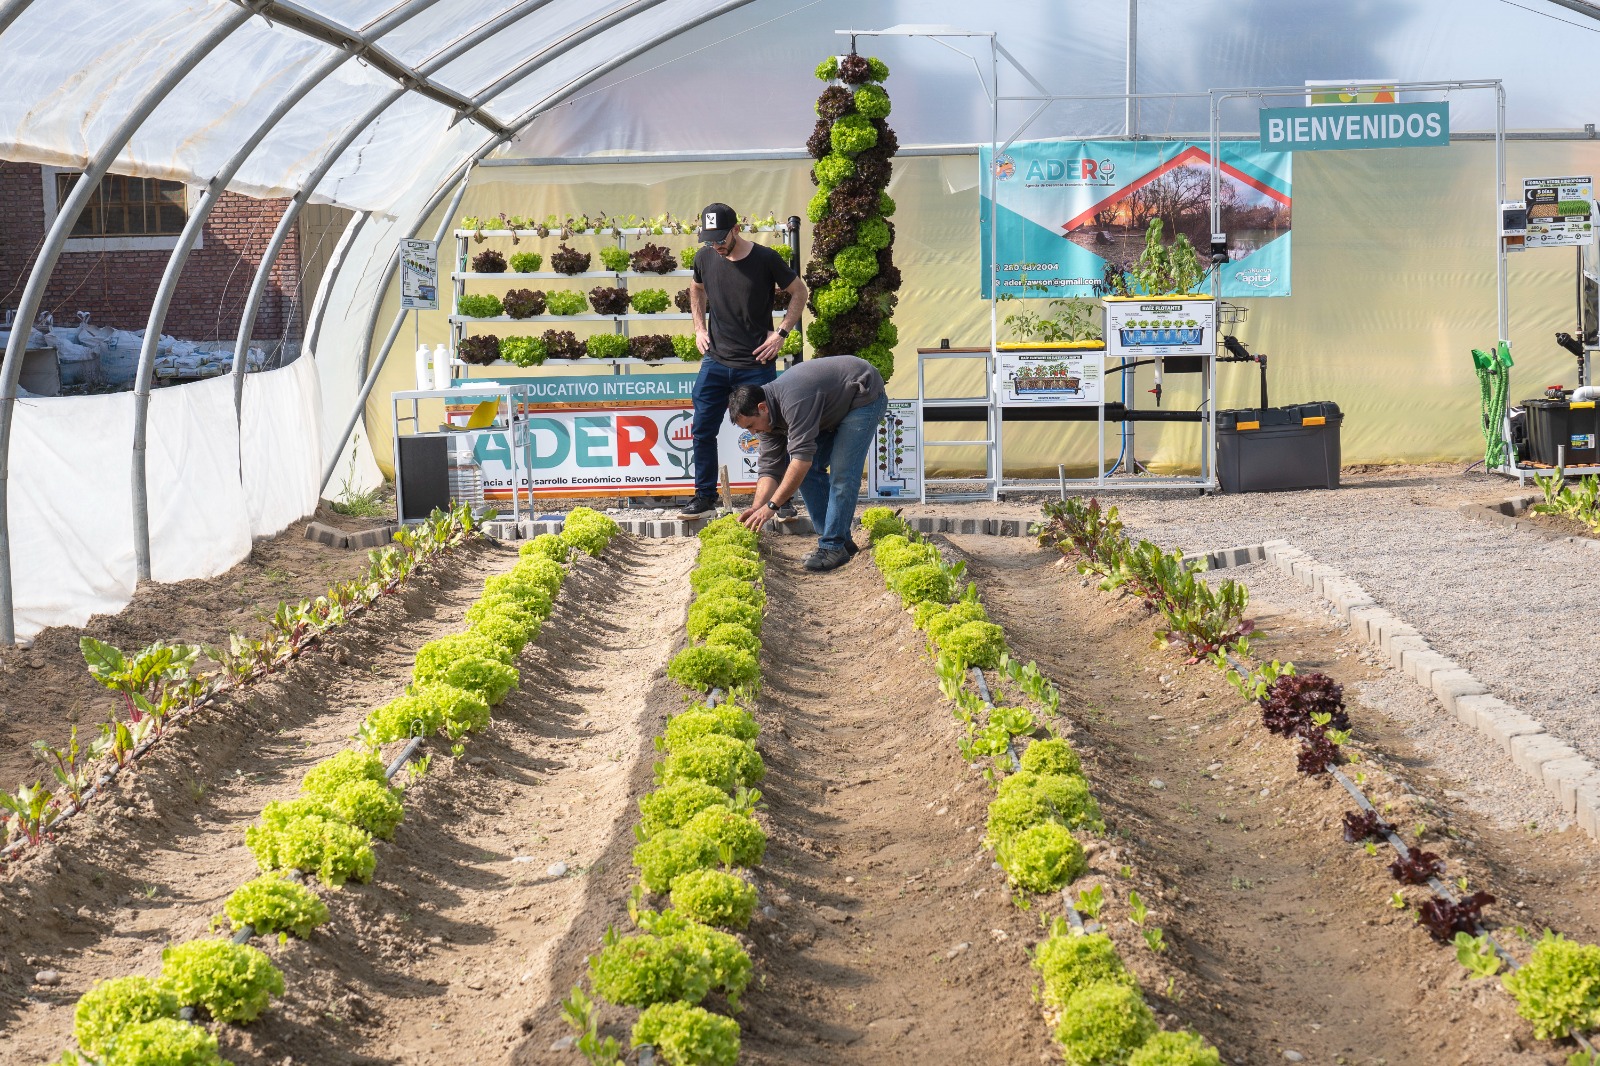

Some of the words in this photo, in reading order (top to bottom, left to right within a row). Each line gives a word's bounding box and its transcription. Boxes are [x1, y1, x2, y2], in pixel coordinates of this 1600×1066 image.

[1268, 112, 1442, 143] BIENVENIDOS
[1025, 158, 1098, 181] ADER
[518, 382, 599, 397] DUCATIVO
[603, 380, 675, 396] INTEGRAL
[472, 415, 661, 471] ADER
[483, 478, 503, 487] ncia
[521, 476, 568, 487] Dsarrollo
[571, 475, 622, 485] Económico
[625, 474, 662, 484] Rawson
